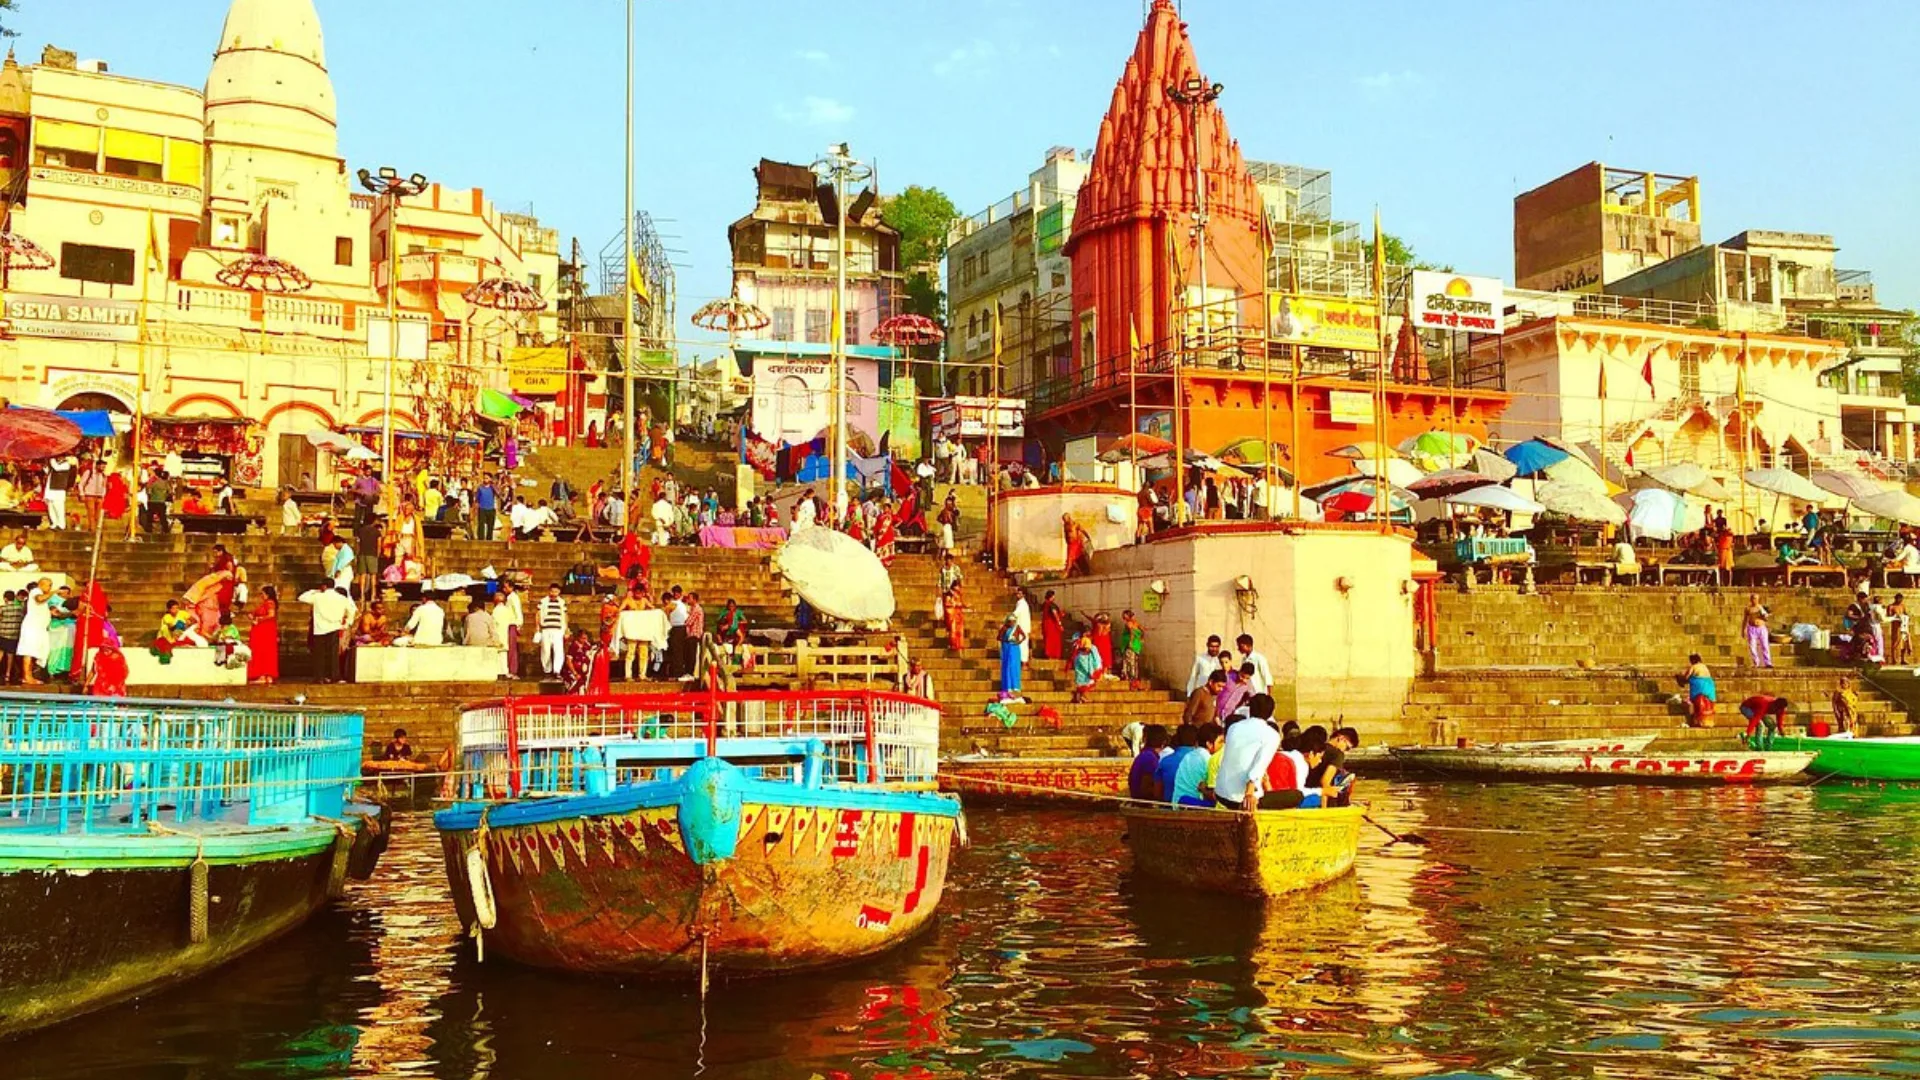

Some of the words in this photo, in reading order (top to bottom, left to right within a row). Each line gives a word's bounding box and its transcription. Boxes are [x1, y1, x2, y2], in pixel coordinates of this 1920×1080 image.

[10, 301, 62, 320] SEVA
[66, 304, 138, 325] SAMITI
[1456, 299, 1492, 315] जागरण
[525, 377, 550, 385] GHAT
